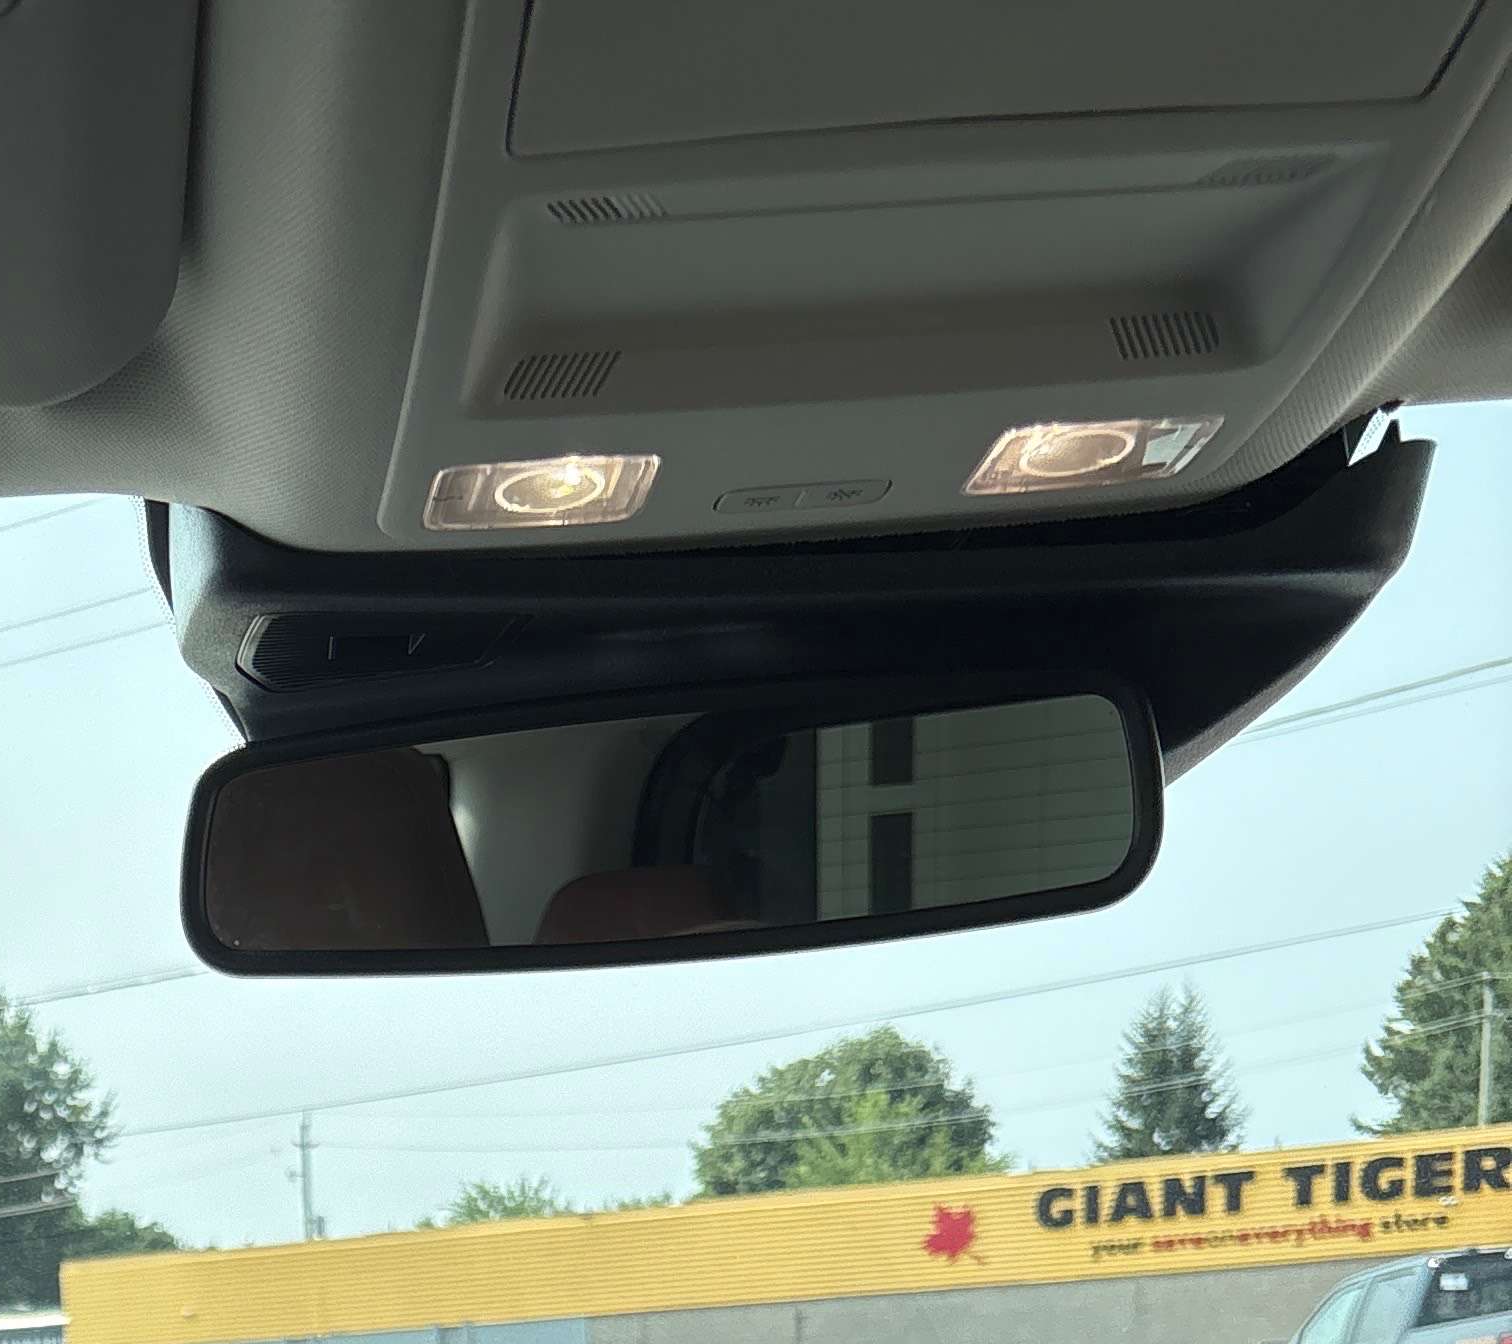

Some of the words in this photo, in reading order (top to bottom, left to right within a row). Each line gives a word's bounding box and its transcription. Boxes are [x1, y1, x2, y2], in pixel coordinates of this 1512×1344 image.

[1035, 1169, 1256, 1230] GIANT
[1281, 1146, 1512, 1207] TIGER
[1380, 1209, 1450, 1235] store
